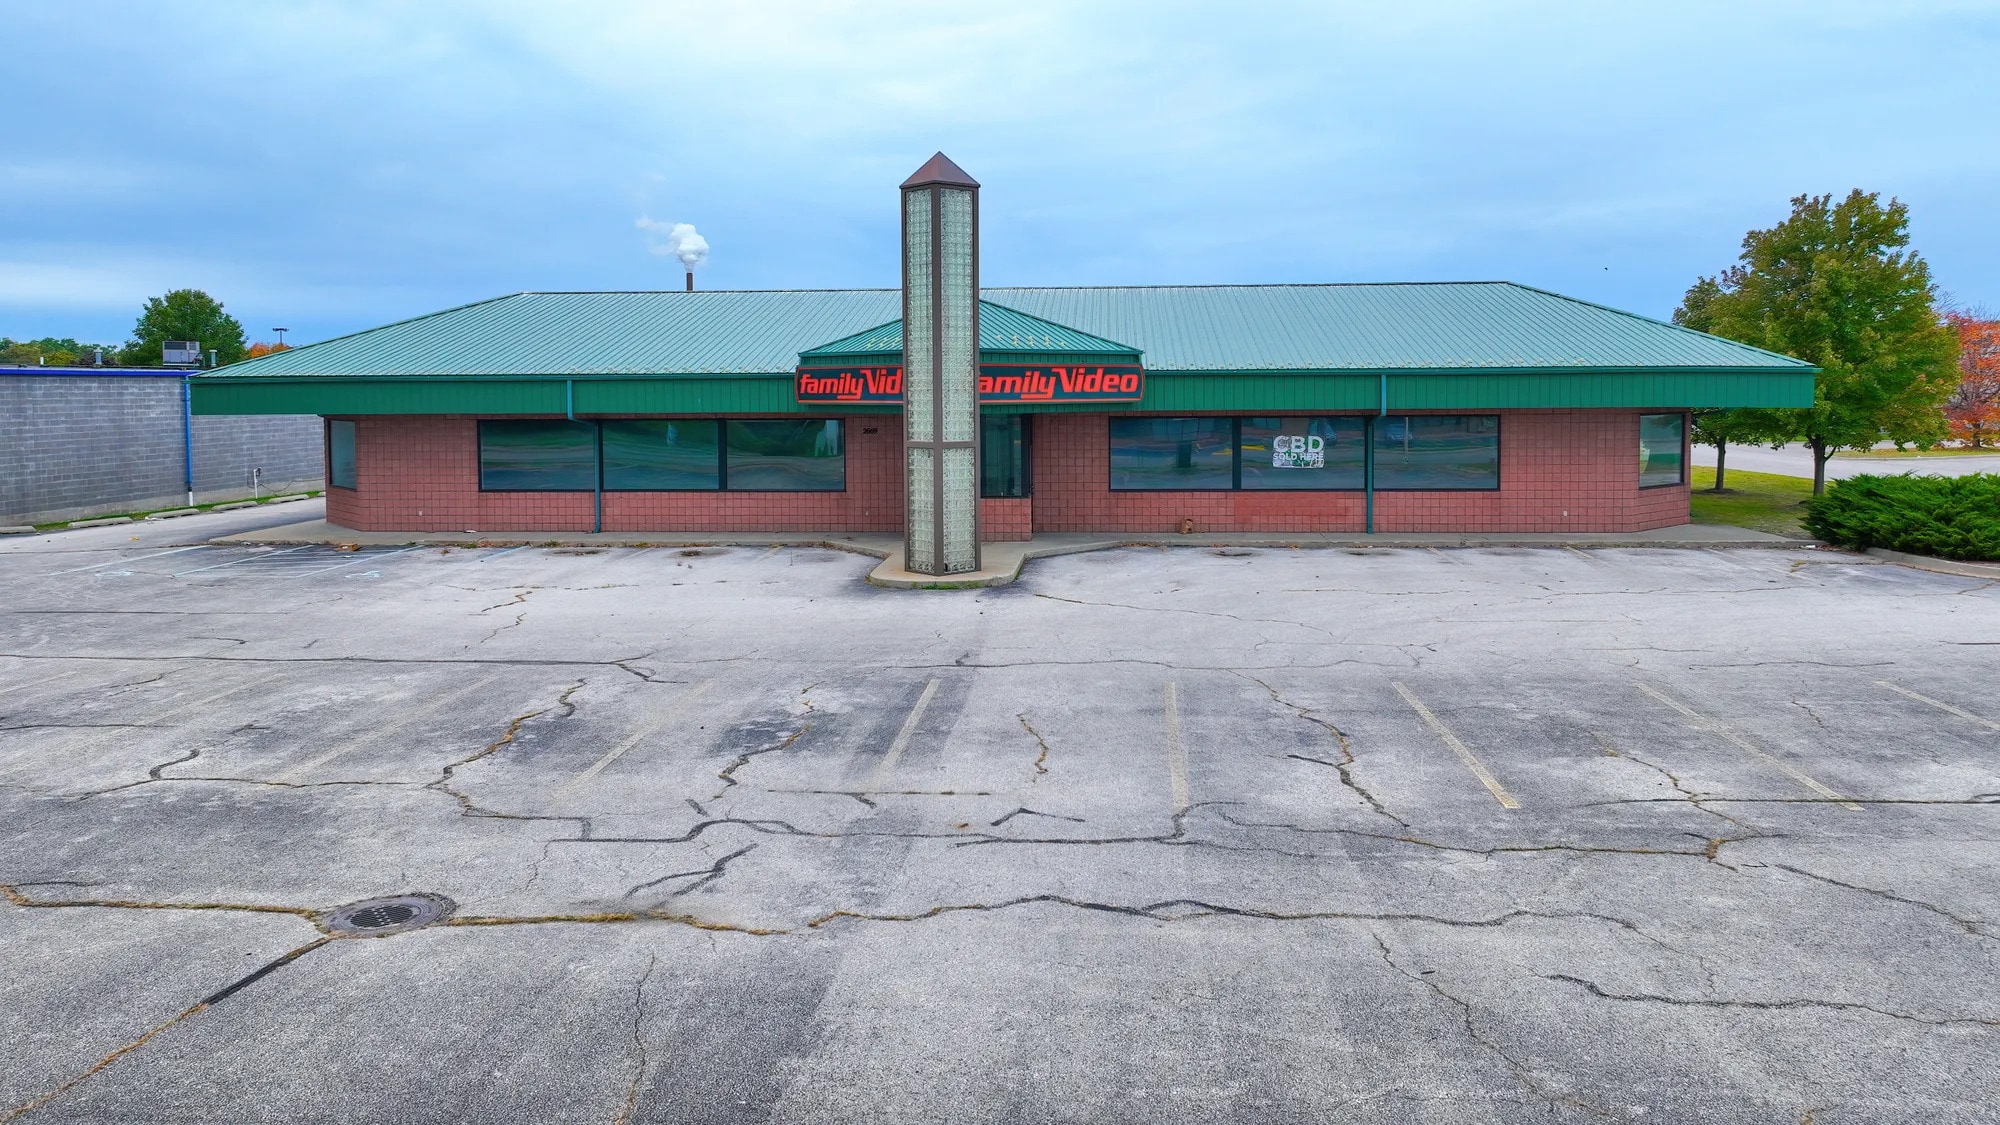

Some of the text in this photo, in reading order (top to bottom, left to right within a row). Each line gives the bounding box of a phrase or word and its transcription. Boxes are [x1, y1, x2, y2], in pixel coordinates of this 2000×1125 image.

[800, 369, 903, 399] family Vid
[979, 368, 1138, 399] amily Video
[1273, 435, 1324, 452] CBD
